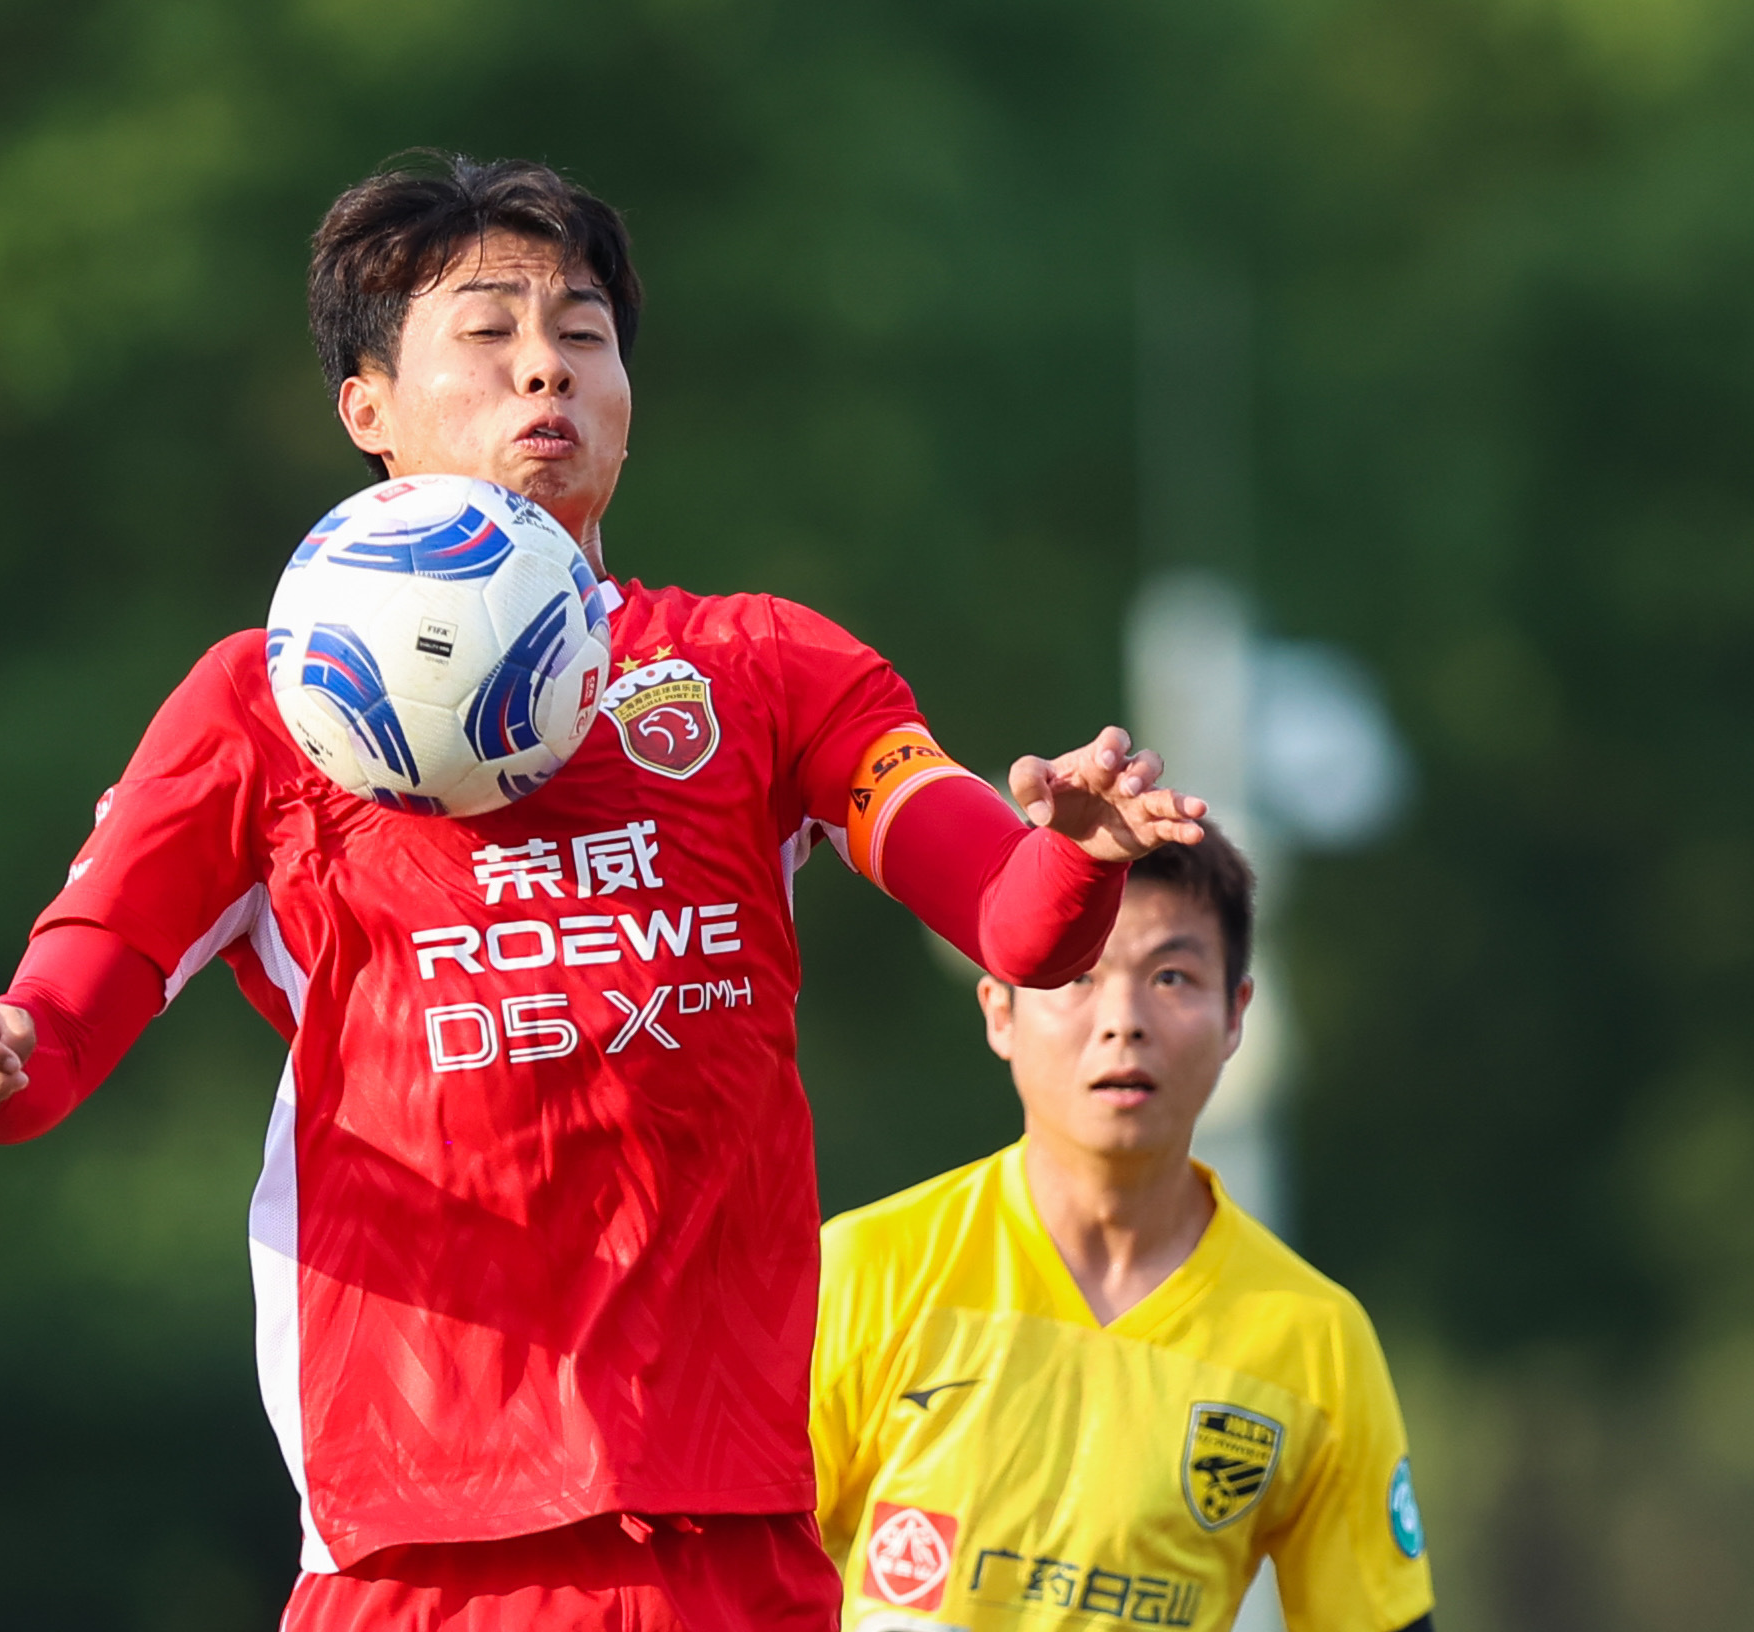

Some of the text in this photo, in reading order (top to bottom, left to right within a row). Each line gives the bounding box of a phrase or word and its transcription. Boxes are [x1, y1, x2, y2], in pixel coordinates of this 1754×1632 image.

[427, 624, 448, 637] FIFA
[471, 819, 664, 906] 荣威
[410, 902, 742, 981] ROEWE
[969, 1547, 1203, 1627] 广药白云山
